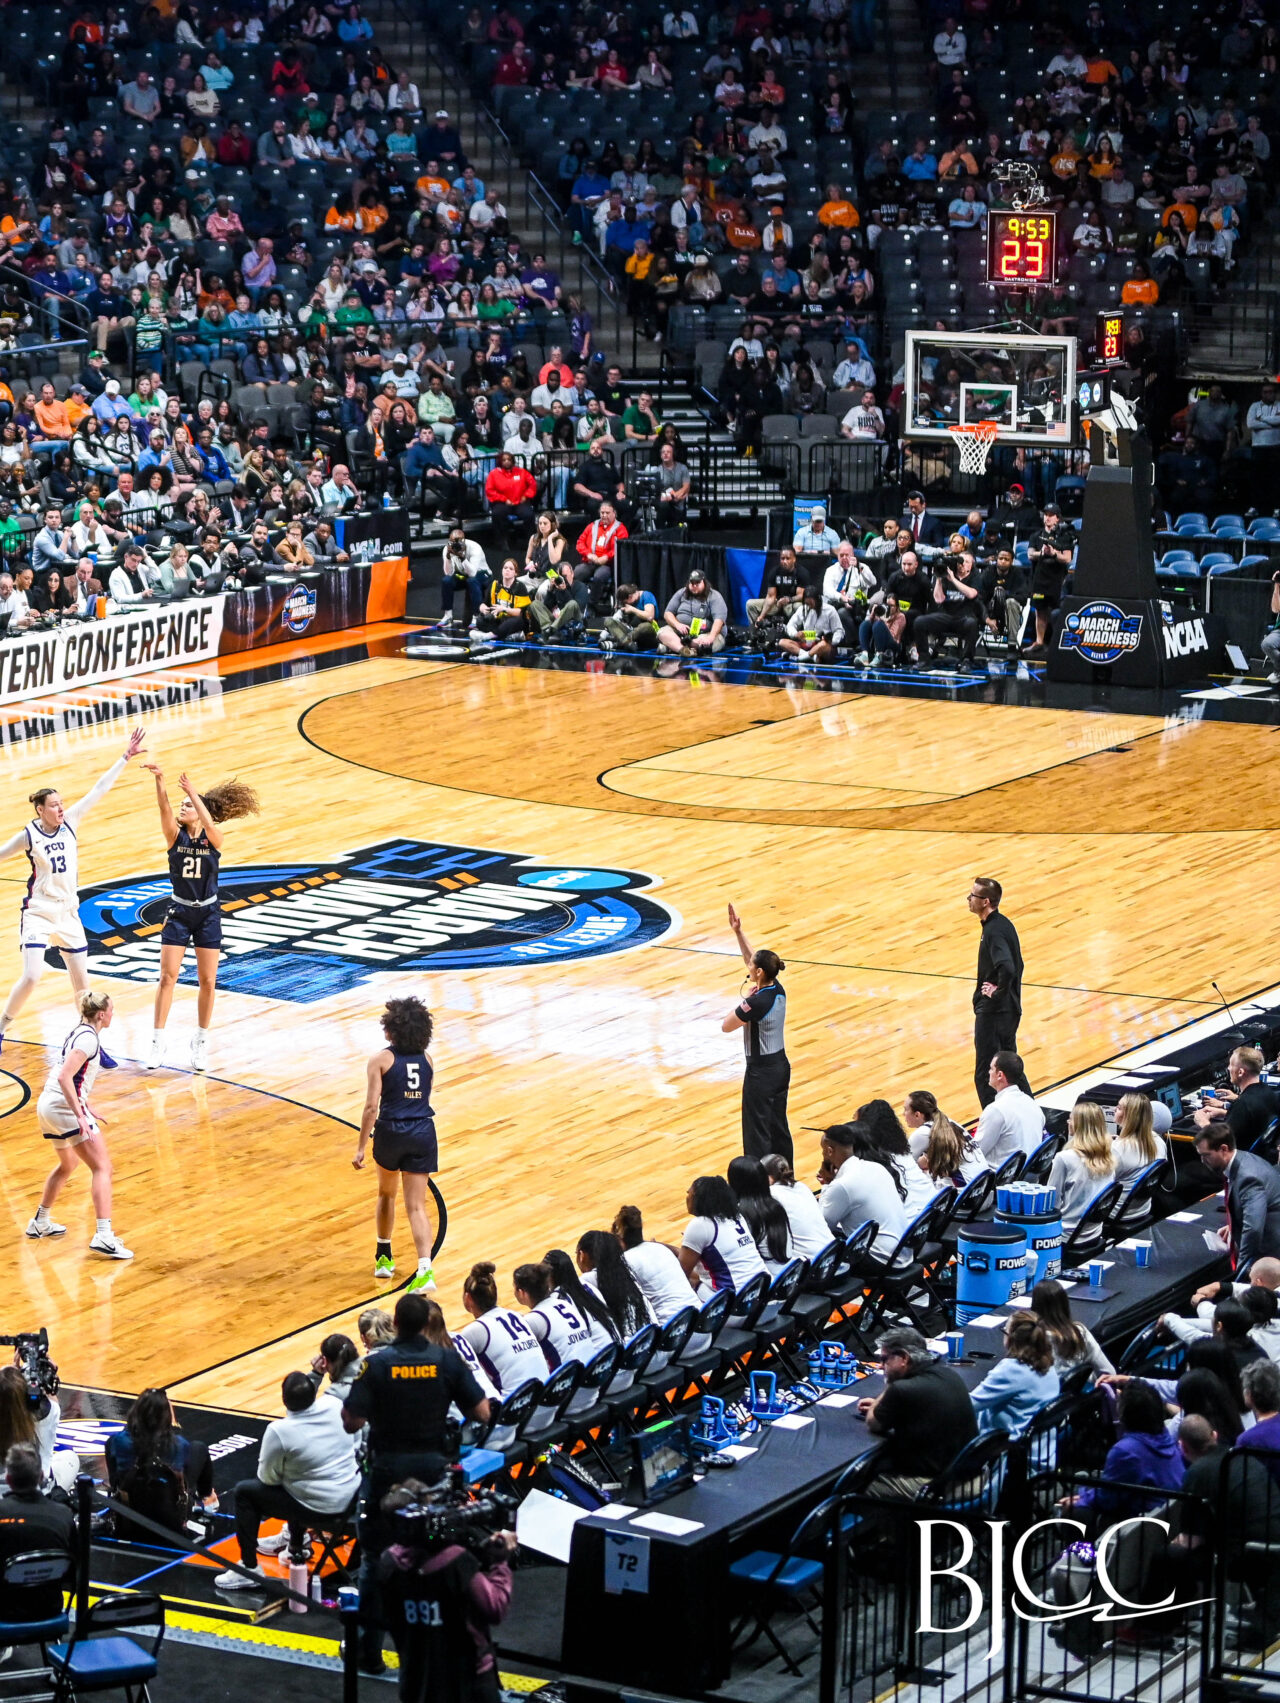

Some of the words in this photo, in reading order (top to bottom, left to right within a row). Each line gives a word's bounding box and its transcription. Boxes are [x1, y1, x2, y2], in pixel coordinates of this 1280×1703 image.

[1008, 218, 1049, 239] 9:53
[1001, 240, 1043, 276] 23
[1105, 337, 1117, 357] 23
[1078, 617, 1121, 632] MARCH
[63, 606, 213, 680] CONFERENCE
[1083, 630, 1138, 646] MADNESS
[1162, 618, 1209, 660] NCAA
[44, 841, 65, 855] TCU
[176, 845, 194, 856] NOTRE
[195, 847, 211, 856] DAME
[50, 855, 67, 874] 13
[181, 857, 202, 879] 21
[291, 882, 581, 960] MARCH
[406, 1063, 420, 1090] 5
[403, 1090, 423, 1099] MILES
[496, 1312, 531, 1341] 14
[553, 1303, 581, 1330] 5
[391, 1365, 437, 1379] POLICE
[617, 1552, 639, 1572] T2
[404, 1600, 443, 1627] 891
